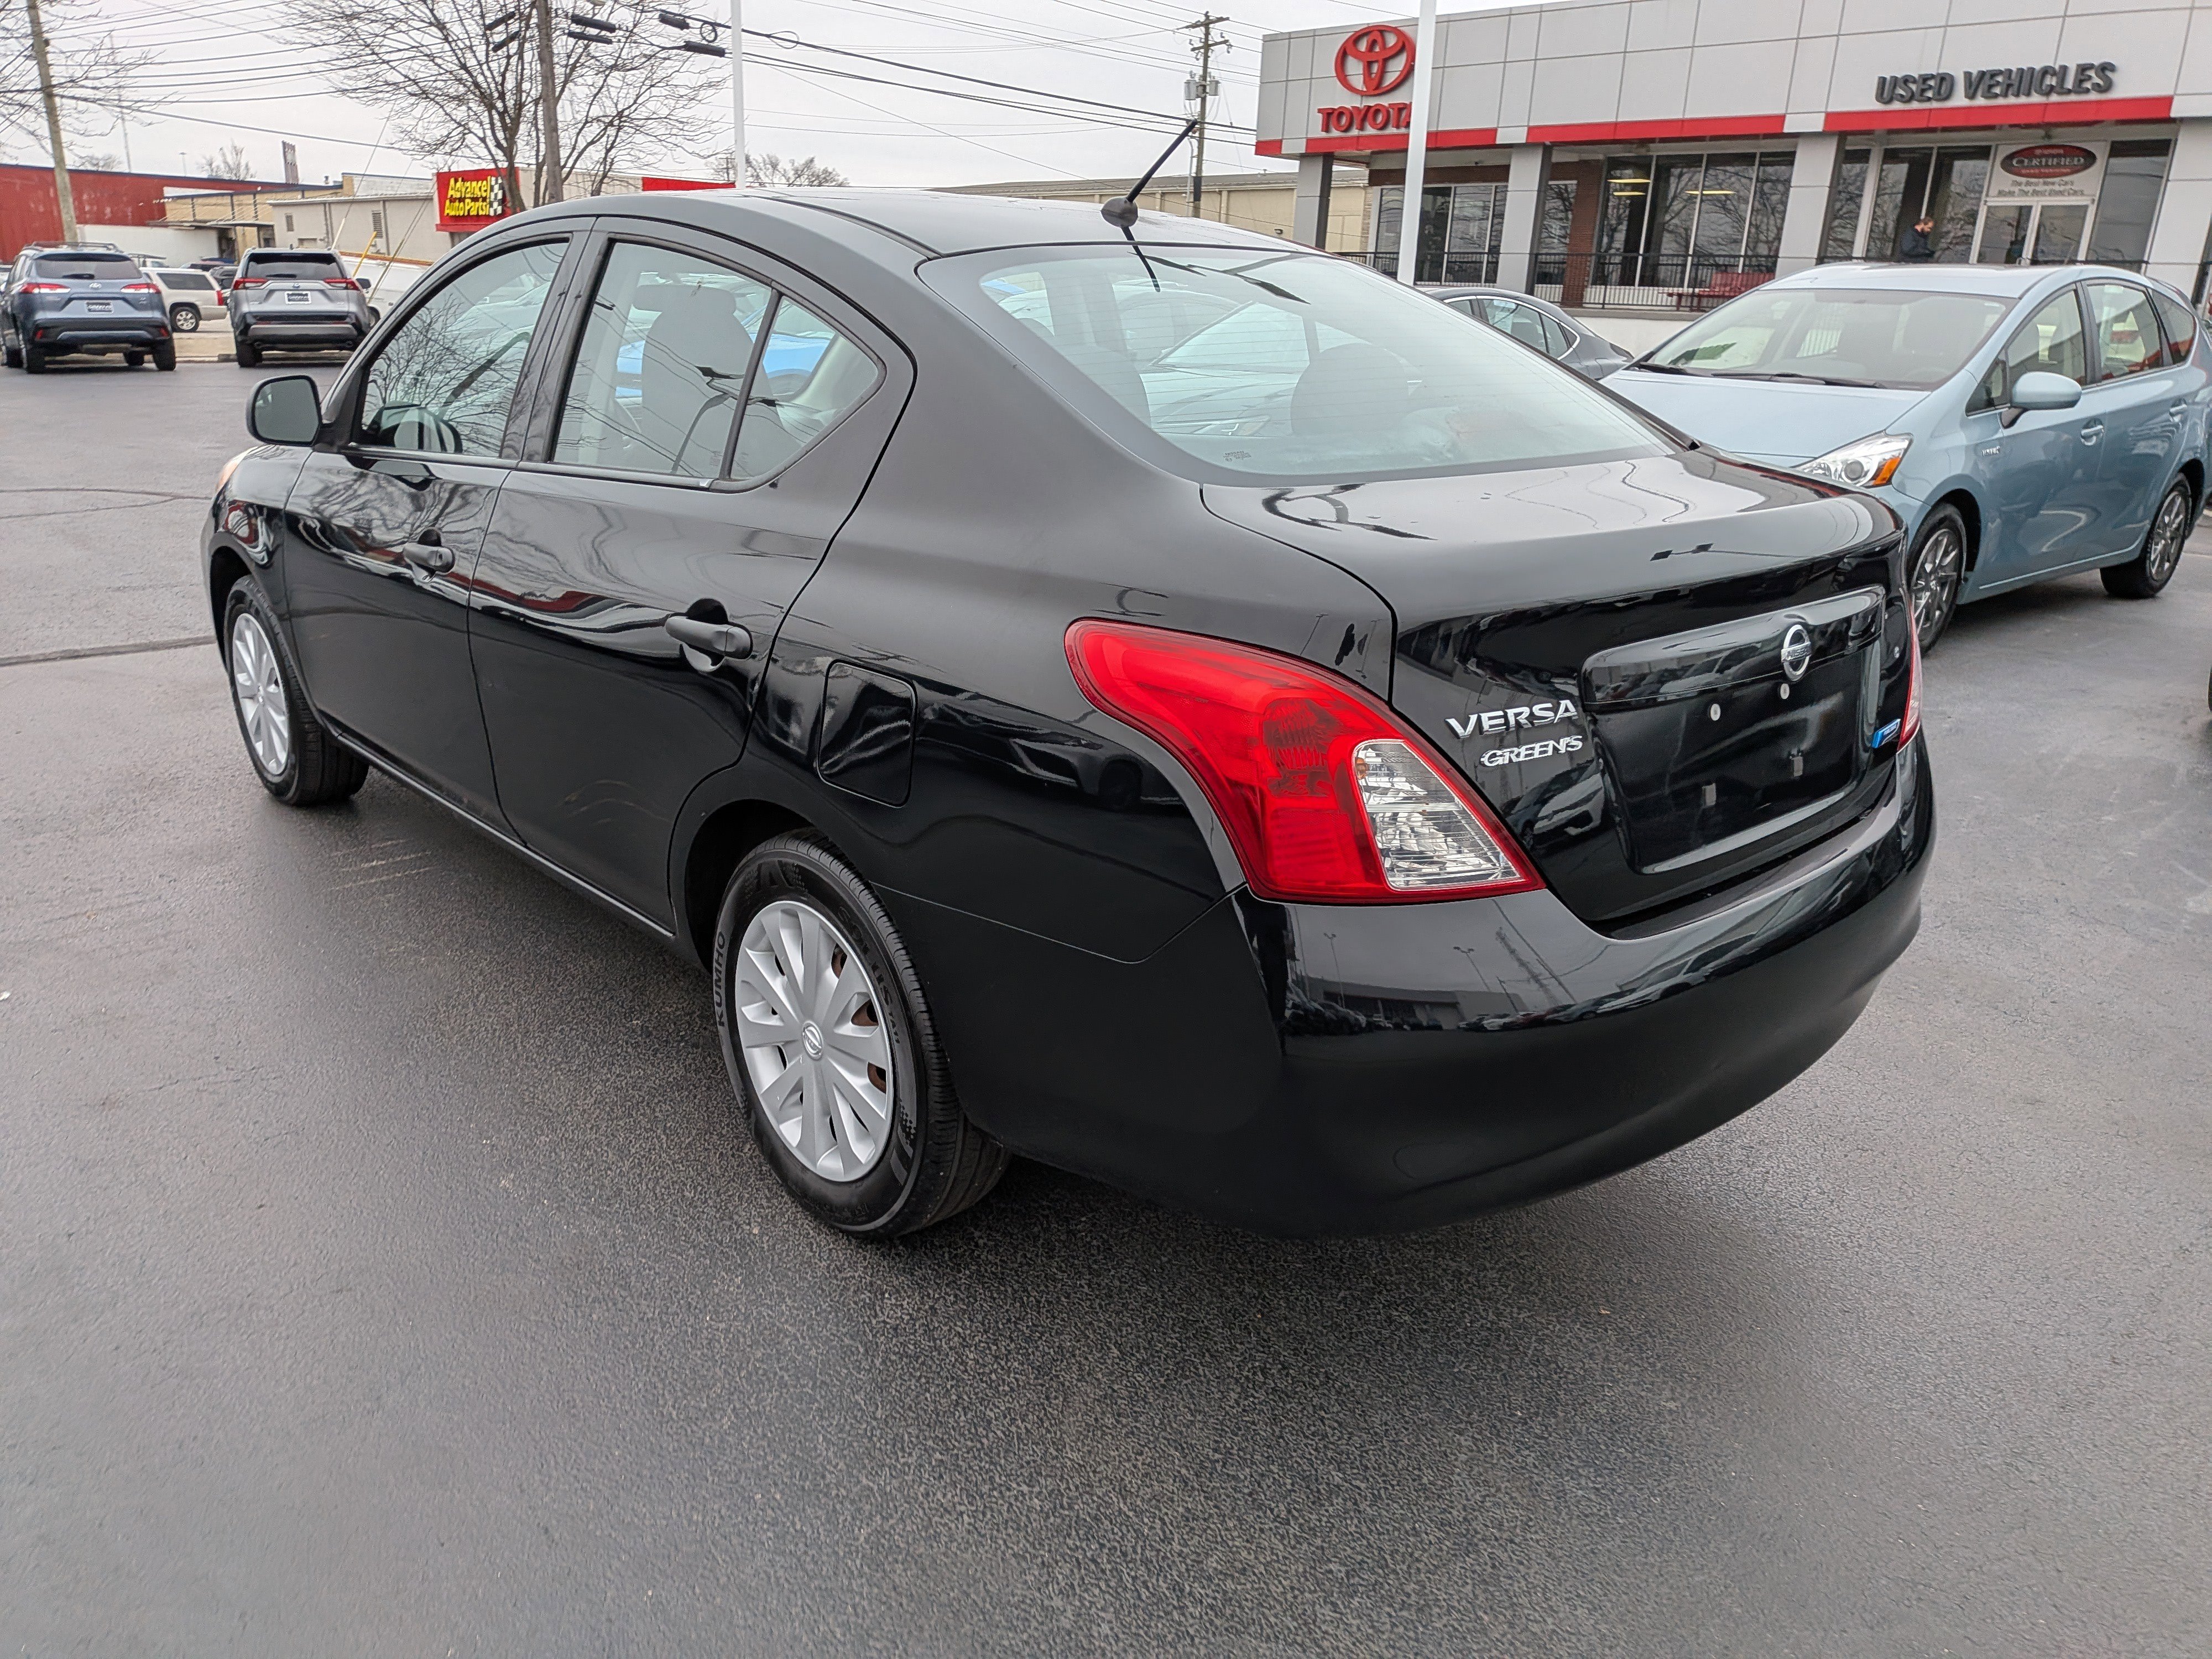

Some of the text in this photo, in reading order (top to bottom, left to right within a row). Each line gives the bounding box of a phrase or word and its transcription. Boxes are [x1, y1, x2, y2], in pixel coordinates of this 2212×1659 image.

[1874, 61, 2116, 105] USED VEHICLES
[2012, 156, 2085, 167] CERTIFIED
[444, 197, 488, 216] Auto Parts
[447, 176, 488, 199] Advance
[1445, 700, 1578, 739] VERSA
[837, 905, 894, 1006] SOLUS
[714, 931, 726, 1027] KUMHO
